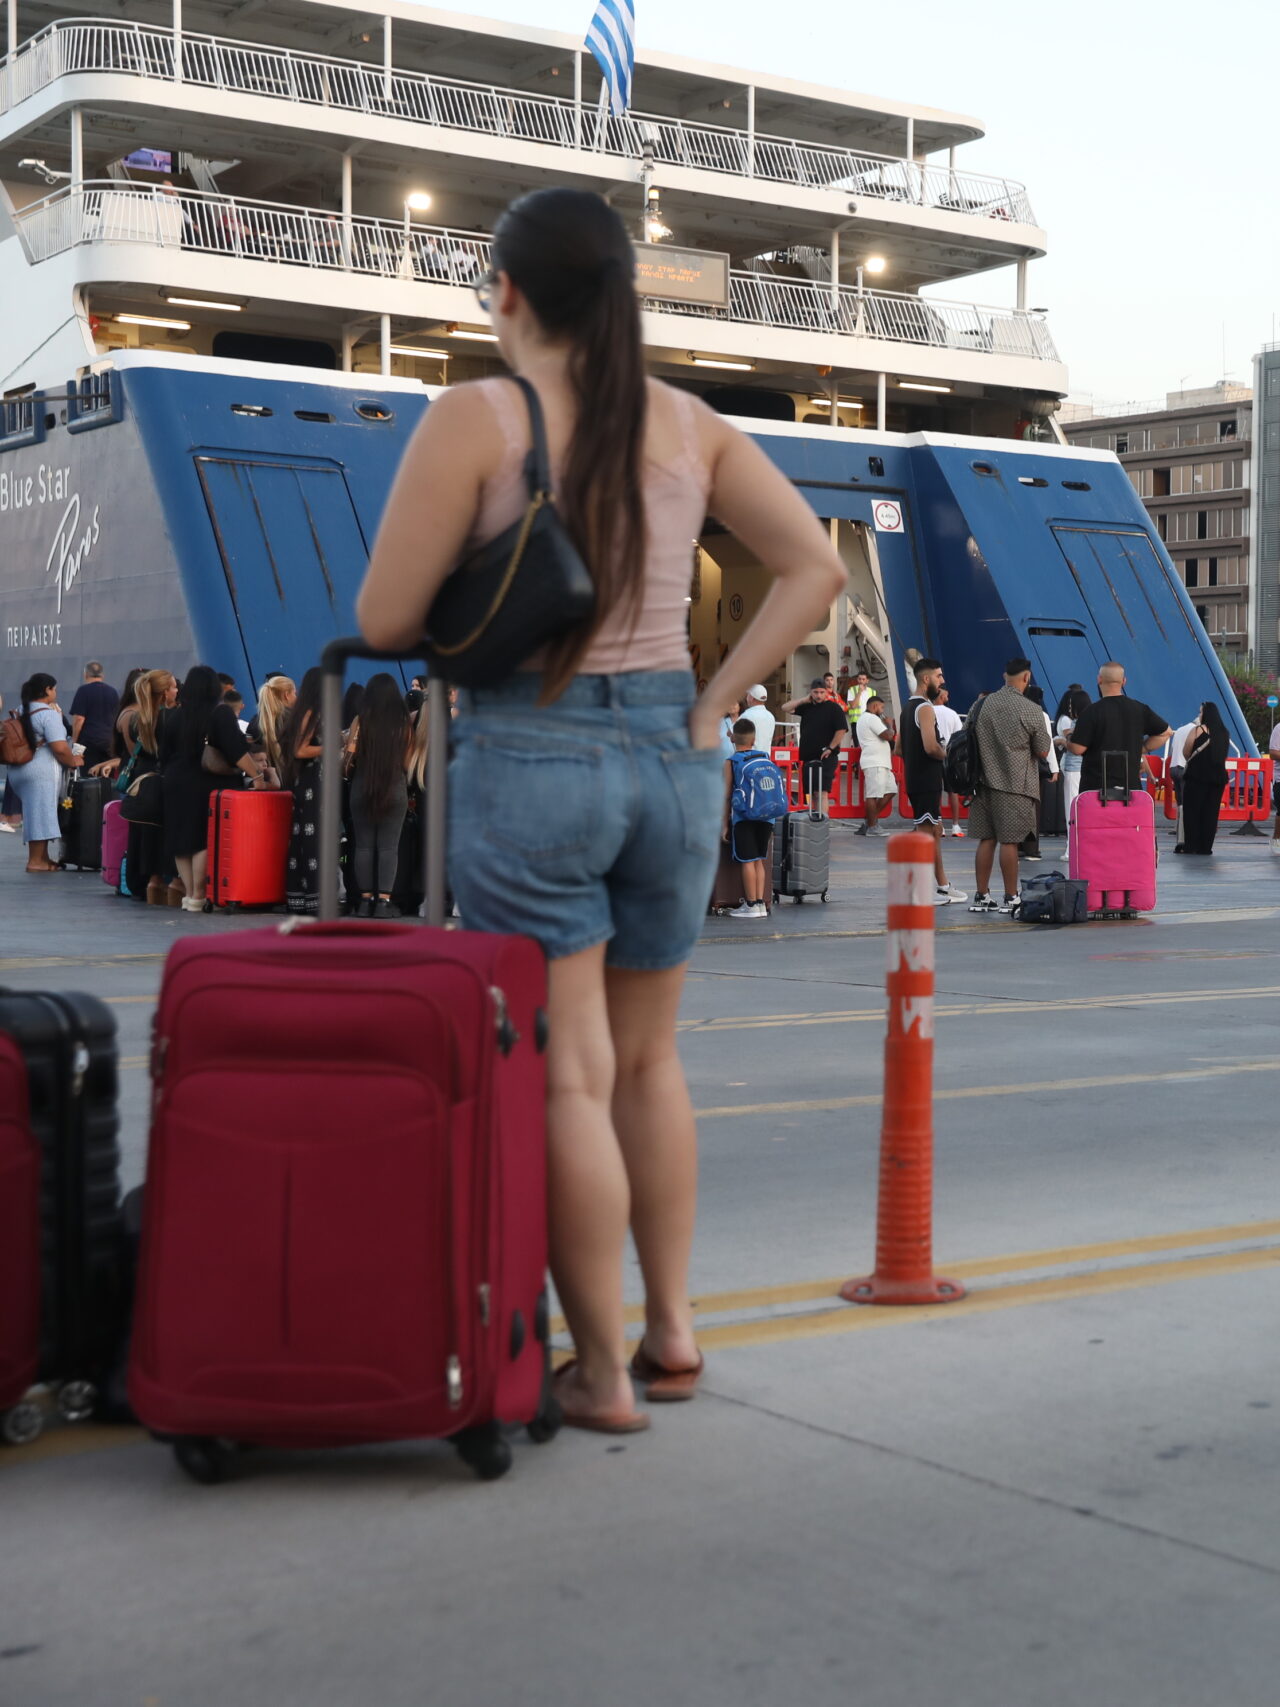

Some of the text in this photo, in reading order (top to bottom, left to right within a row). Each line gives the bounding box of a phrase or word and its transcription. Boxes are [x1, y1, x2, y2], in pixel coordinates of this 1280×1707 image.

[0, 464, 70, 511] Blue Star
[46, 493, 100, 614] Paros
[7, 624, 62, 648] ΠΕΙΡΑΙΕΥΣ
